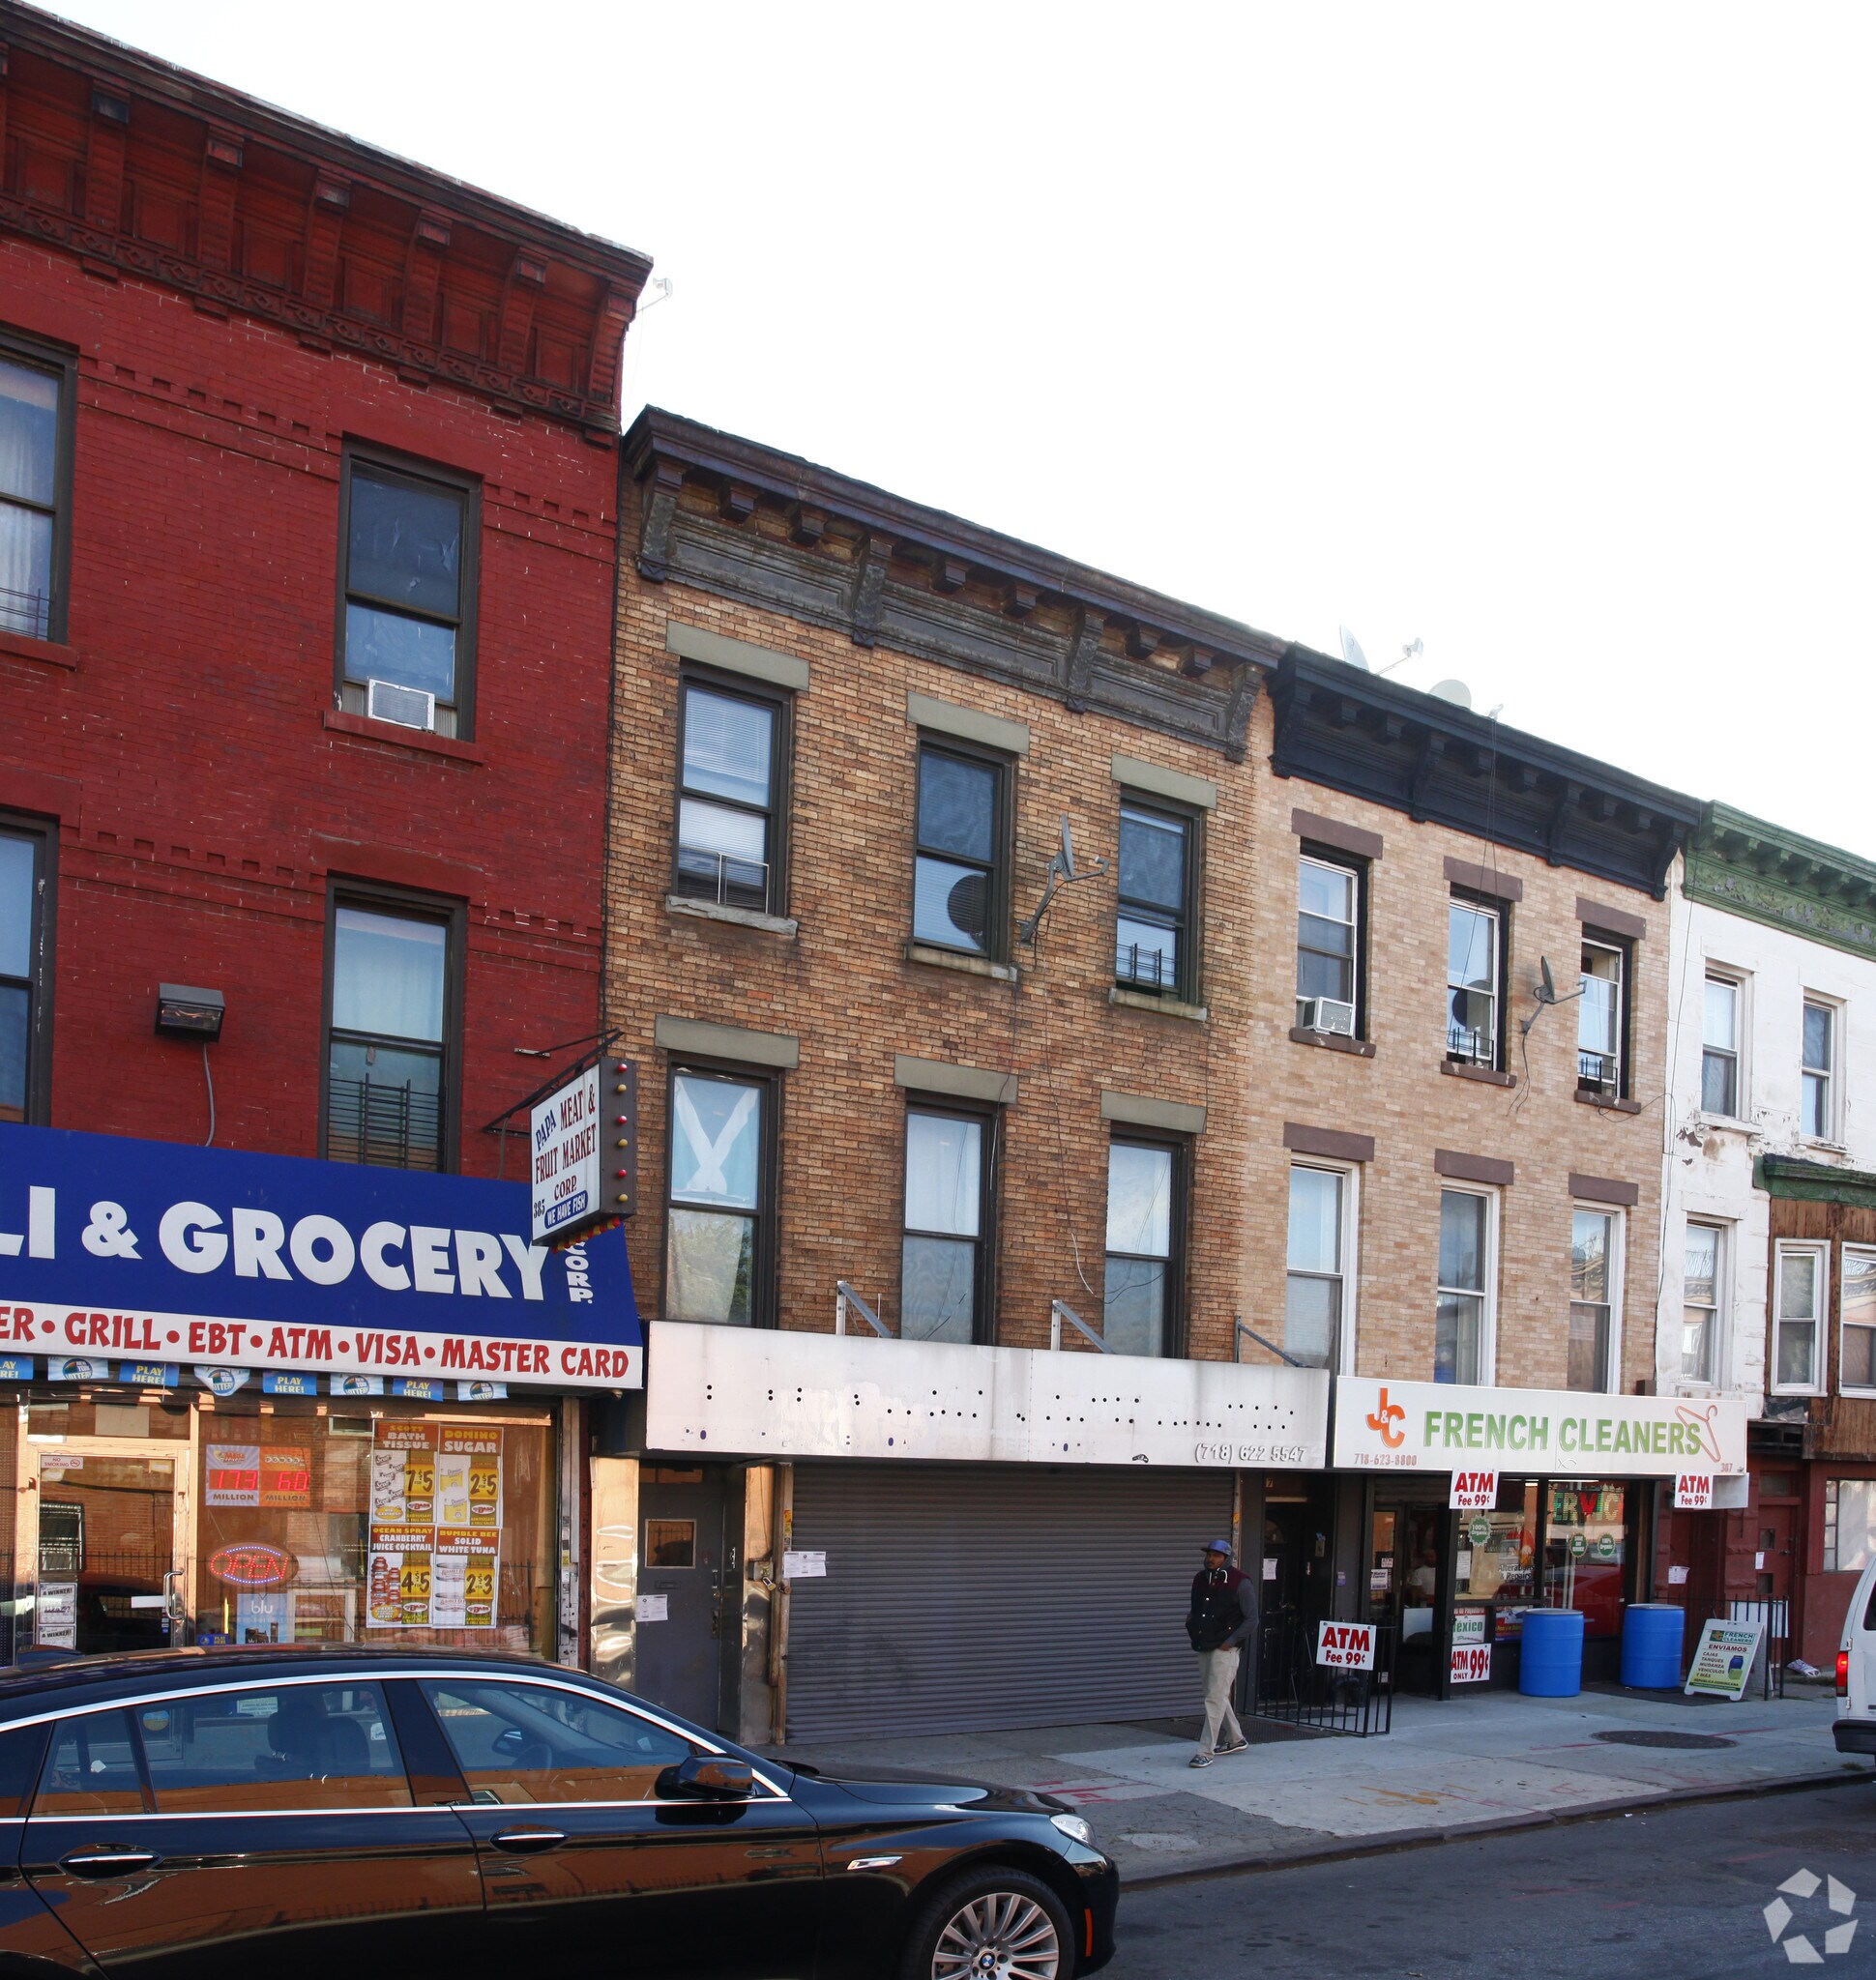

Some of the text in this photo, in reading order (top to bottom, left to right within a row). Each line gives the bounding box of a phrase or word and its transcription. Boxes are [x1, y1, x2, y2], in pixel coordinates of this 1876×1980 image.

[536, 1083, 596, 1151] PAPA MEAT &
[535, 1122, 597, 1184] FRUIT MARKET
[554, 1175, 577, 1201] CORP.
[533, 1199, 545, 1218] 385
[546, 1192, 586, 1226] WE HAVE FISH
[0, 1185, 549, 1301] I & GROCERY
[64, 1312, 161, 1351] GRILL
[189, 1322, 247, 1355] EBT
[267, 1326, 333, 1360] ATM
[355, 1333, 422, 1366] VISA
[440, 1338, 550, 1374] MASTER
[561, 1346, 630, 1379] CARD
[132, 1374, 164, 1384] HERE!
[135, 1365, 164, 1375] PLAY
[274, 1384, 305, 1393] HERE!
[277, 1376, 302, 1385] PLAY
[406, 1381, 430, 1390] PLAY
[402, 1388, 431, 1399] HERE!
[388, 1432, 425, 1441] BATH
[445, 1431, 498, 1440] DOMINO
[1423, 1411, 1548, 1451] FRENCH
[1559, 1416, 1701, 1455] CLEANERS
[382, 1441, 429, 1449] TISSUE
[445, 1441, 497, 1453] SUGAR
[1195, 1443, 1306, 1464] (718) 622 5547
[1353, 1453, 1418, 1467] 718-623-8800
[219, 1470, 258, 1491] 173
[278, 1470, 308, 1491] 60
[423, 1470, 433, 1492] 5
[470, 1473, 481, 1495] 2
[486, 1474, 497, 1496] 5
[1454, 1472, 1494, 1492] ATM
[1678, 1475, 1710, 1494] ATM
[1457, 1494, 1490, 1506] Fee 99¢
[1681, 1495, 1692, 1505] Fee
[210, 1553, 289, 1579] OPEN
[401, 1571, 414, 1593] 4
[420, 1571, 430, 1593] 5
[466, 1574, 476, 1594] 2
[484, 1574, 492, 1594] 3
[1507, 1572, 1532, 1581] Repairs
[251, 1599, 273, 1614] blu
[1321, 1627, 1369, 1652] ATM
[1325, 1650, 1365, 1665] Fee 99¢
[1451, 1651, 1468, 1670] ATM
